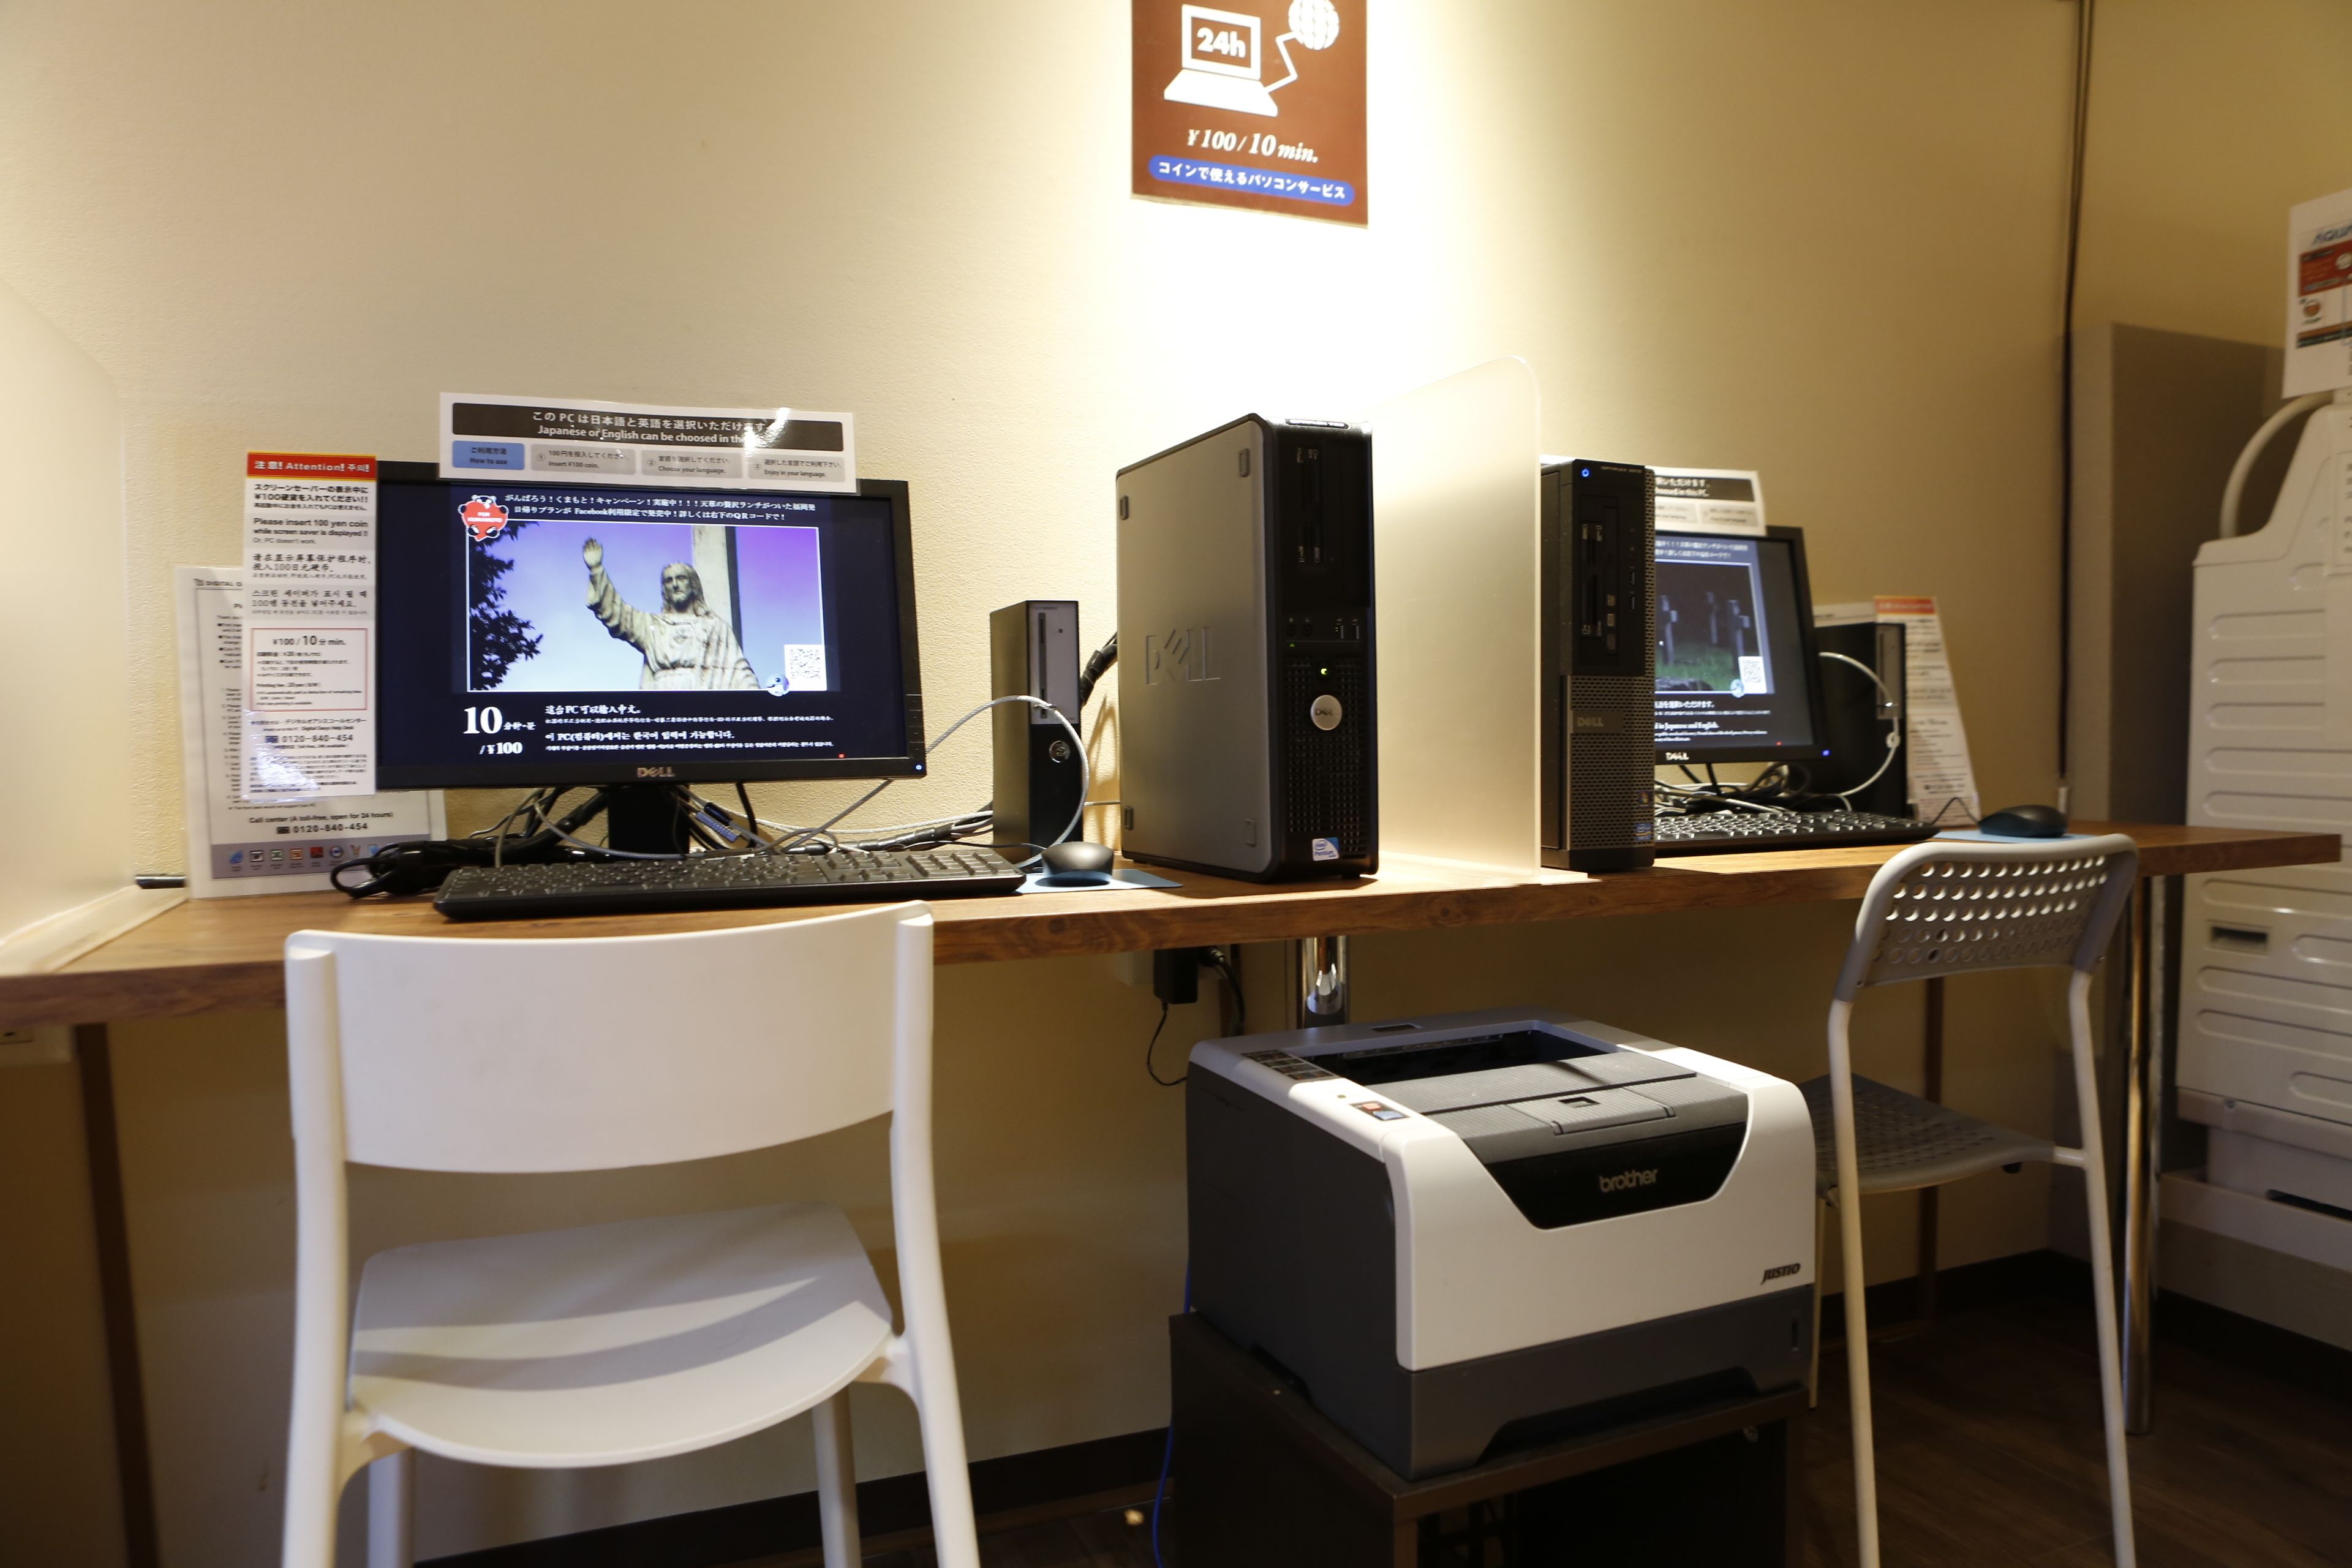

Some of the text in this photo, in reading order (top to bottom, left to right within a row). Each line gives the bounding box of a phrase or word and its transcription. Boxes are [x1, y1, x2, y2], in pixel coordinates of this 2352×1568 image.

[1197, 28, 1246, 58] 24h
[1278, 142, 1318, 163] min.
[1159, 162, 1345, 199] コインで使えるパソコンサービス
[538, 425, 586, 437] Japanese
[601, 429, 638, 441] English
[661, 432, 674, 441] be
[676, 432, 717, 443] choosed
[719, 434, 728, 443] in
[286, 462, 345, 472] Attention!
[696, 466, 726, 475] language.
[1145, 627, 1221, 685] DELL
[463, 706, 502, 734] 10
[1577, 717, 1604, 727] DELL
[282, 734, 353, 743] 0120-840-454
[545, 733, 554, 741] 이
[633, 731, 658, 740] 한국어
[662, 731, 687, 740] 입력이
[689, 730, 735, 739] 가능합니다.
[1665, 752, 1689, 761] DELL
[638, 767, 675, 777] DELL
[293, 823, 368, 833] 0120-840-454
[1599, 1169, 1658, 1193] brother
[1760, 1262, 1801, 1286] JUSTIO
